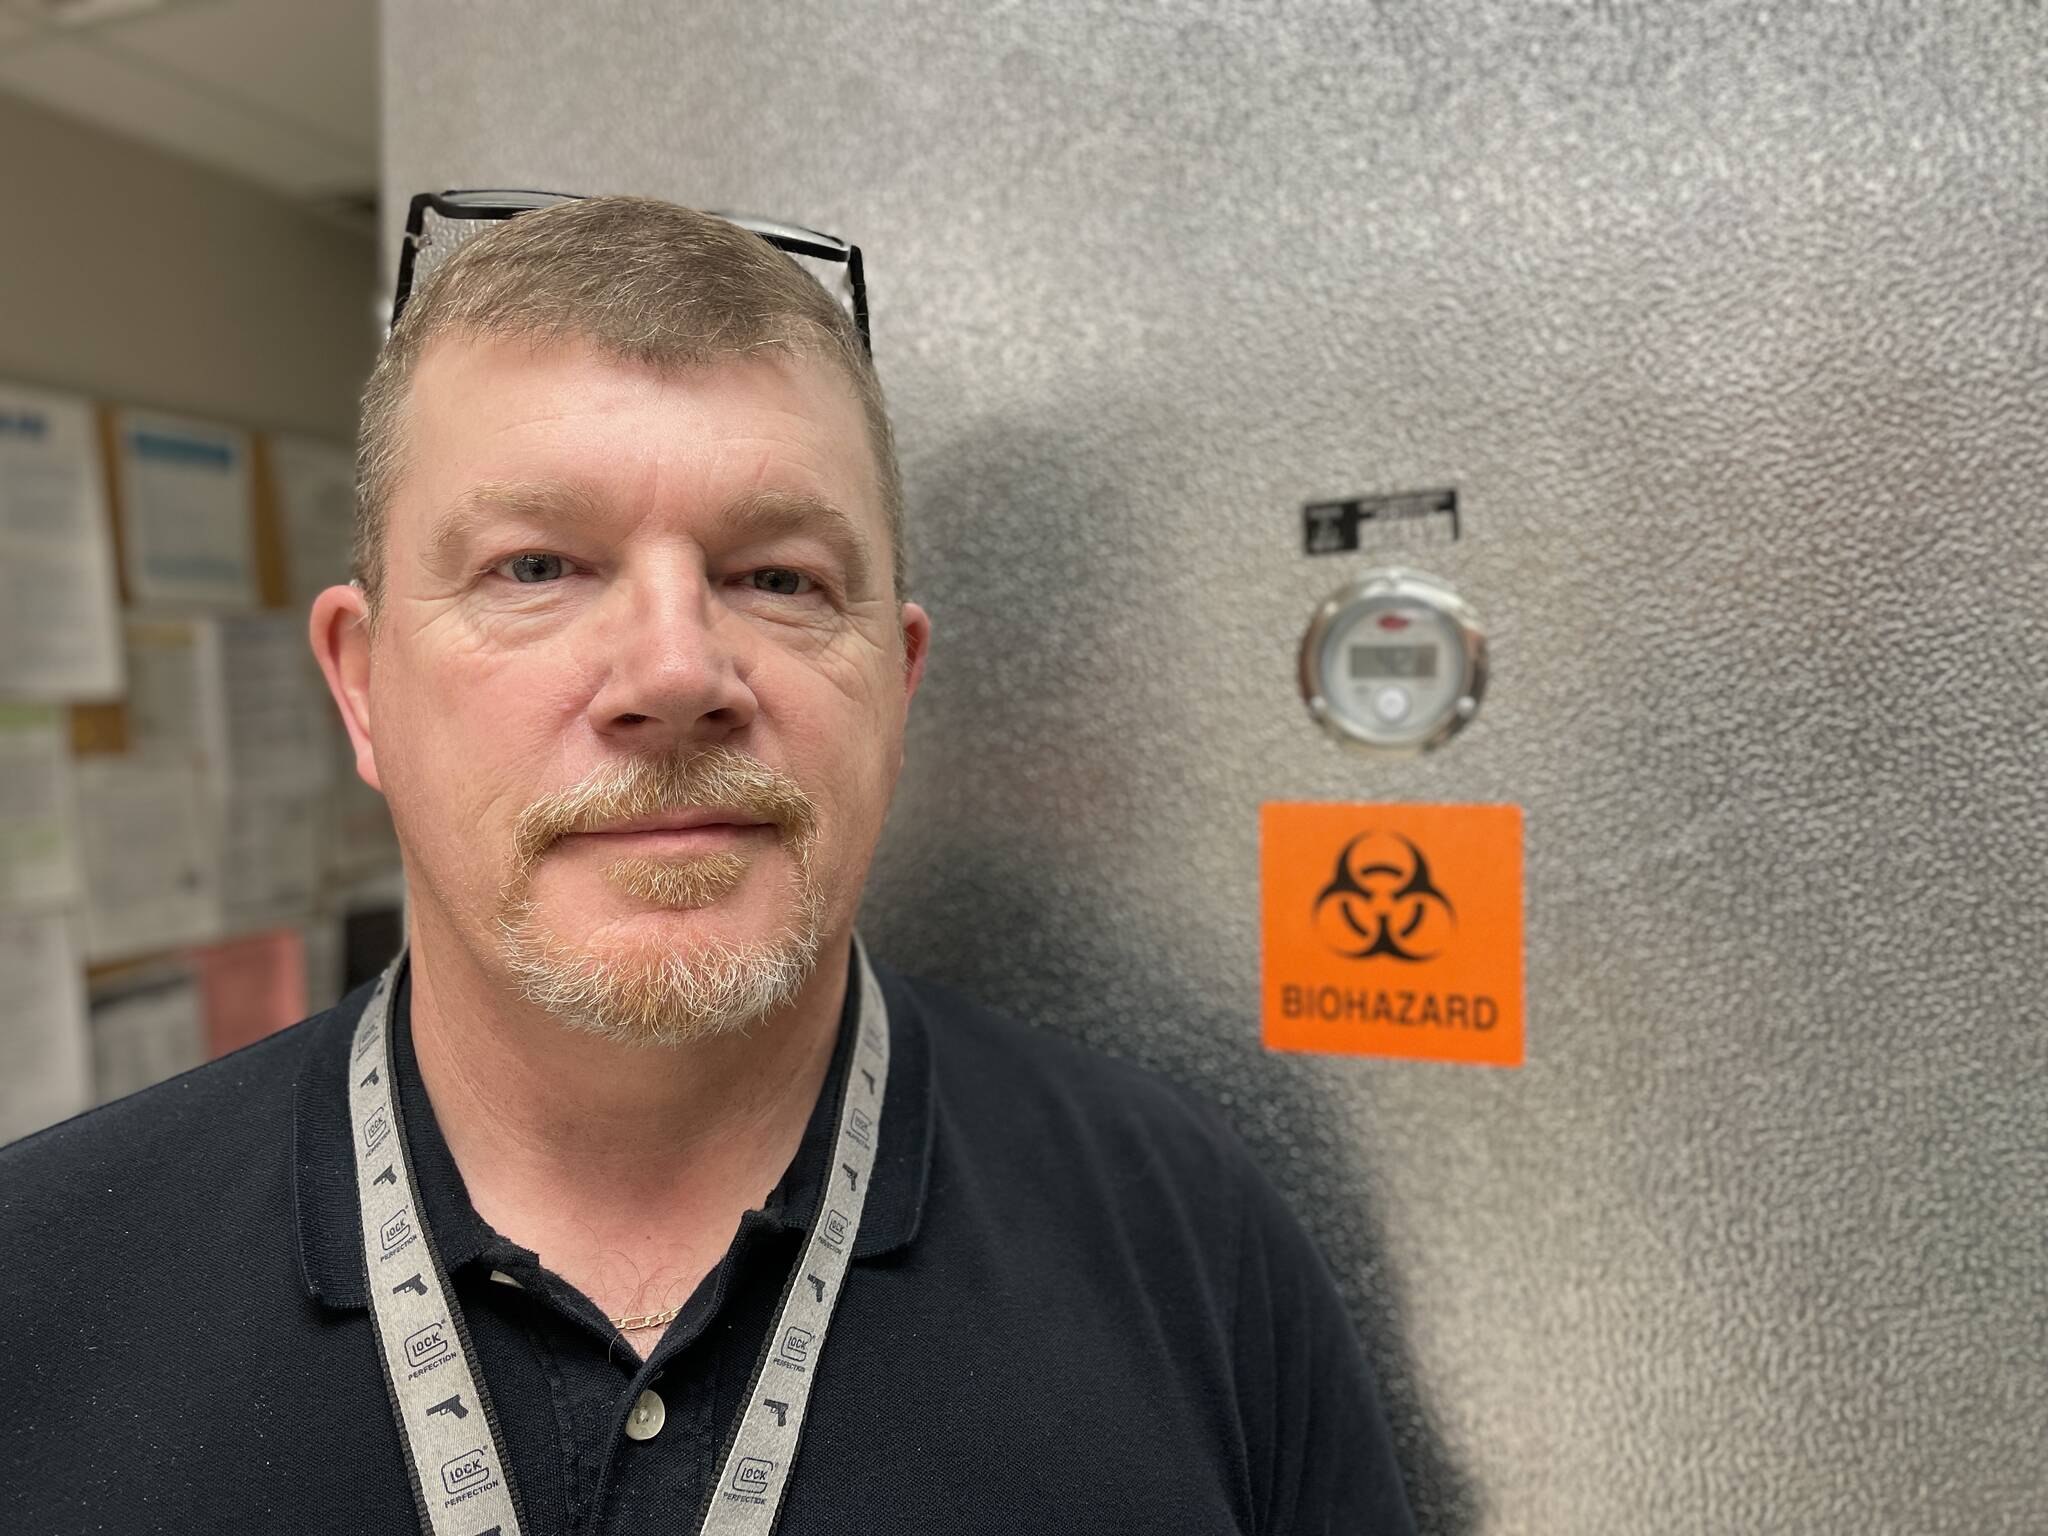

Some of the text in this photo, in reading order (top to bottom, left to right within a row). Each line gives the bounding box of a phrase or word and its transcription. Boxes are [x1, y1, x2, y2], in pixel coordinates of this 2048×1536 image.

[1281, 984, 1498, 1030] BIOHAZARD
[408, 1352, 456, 1381] PERFECTION
[444, 1480, 499, 1508] PERFECTION
